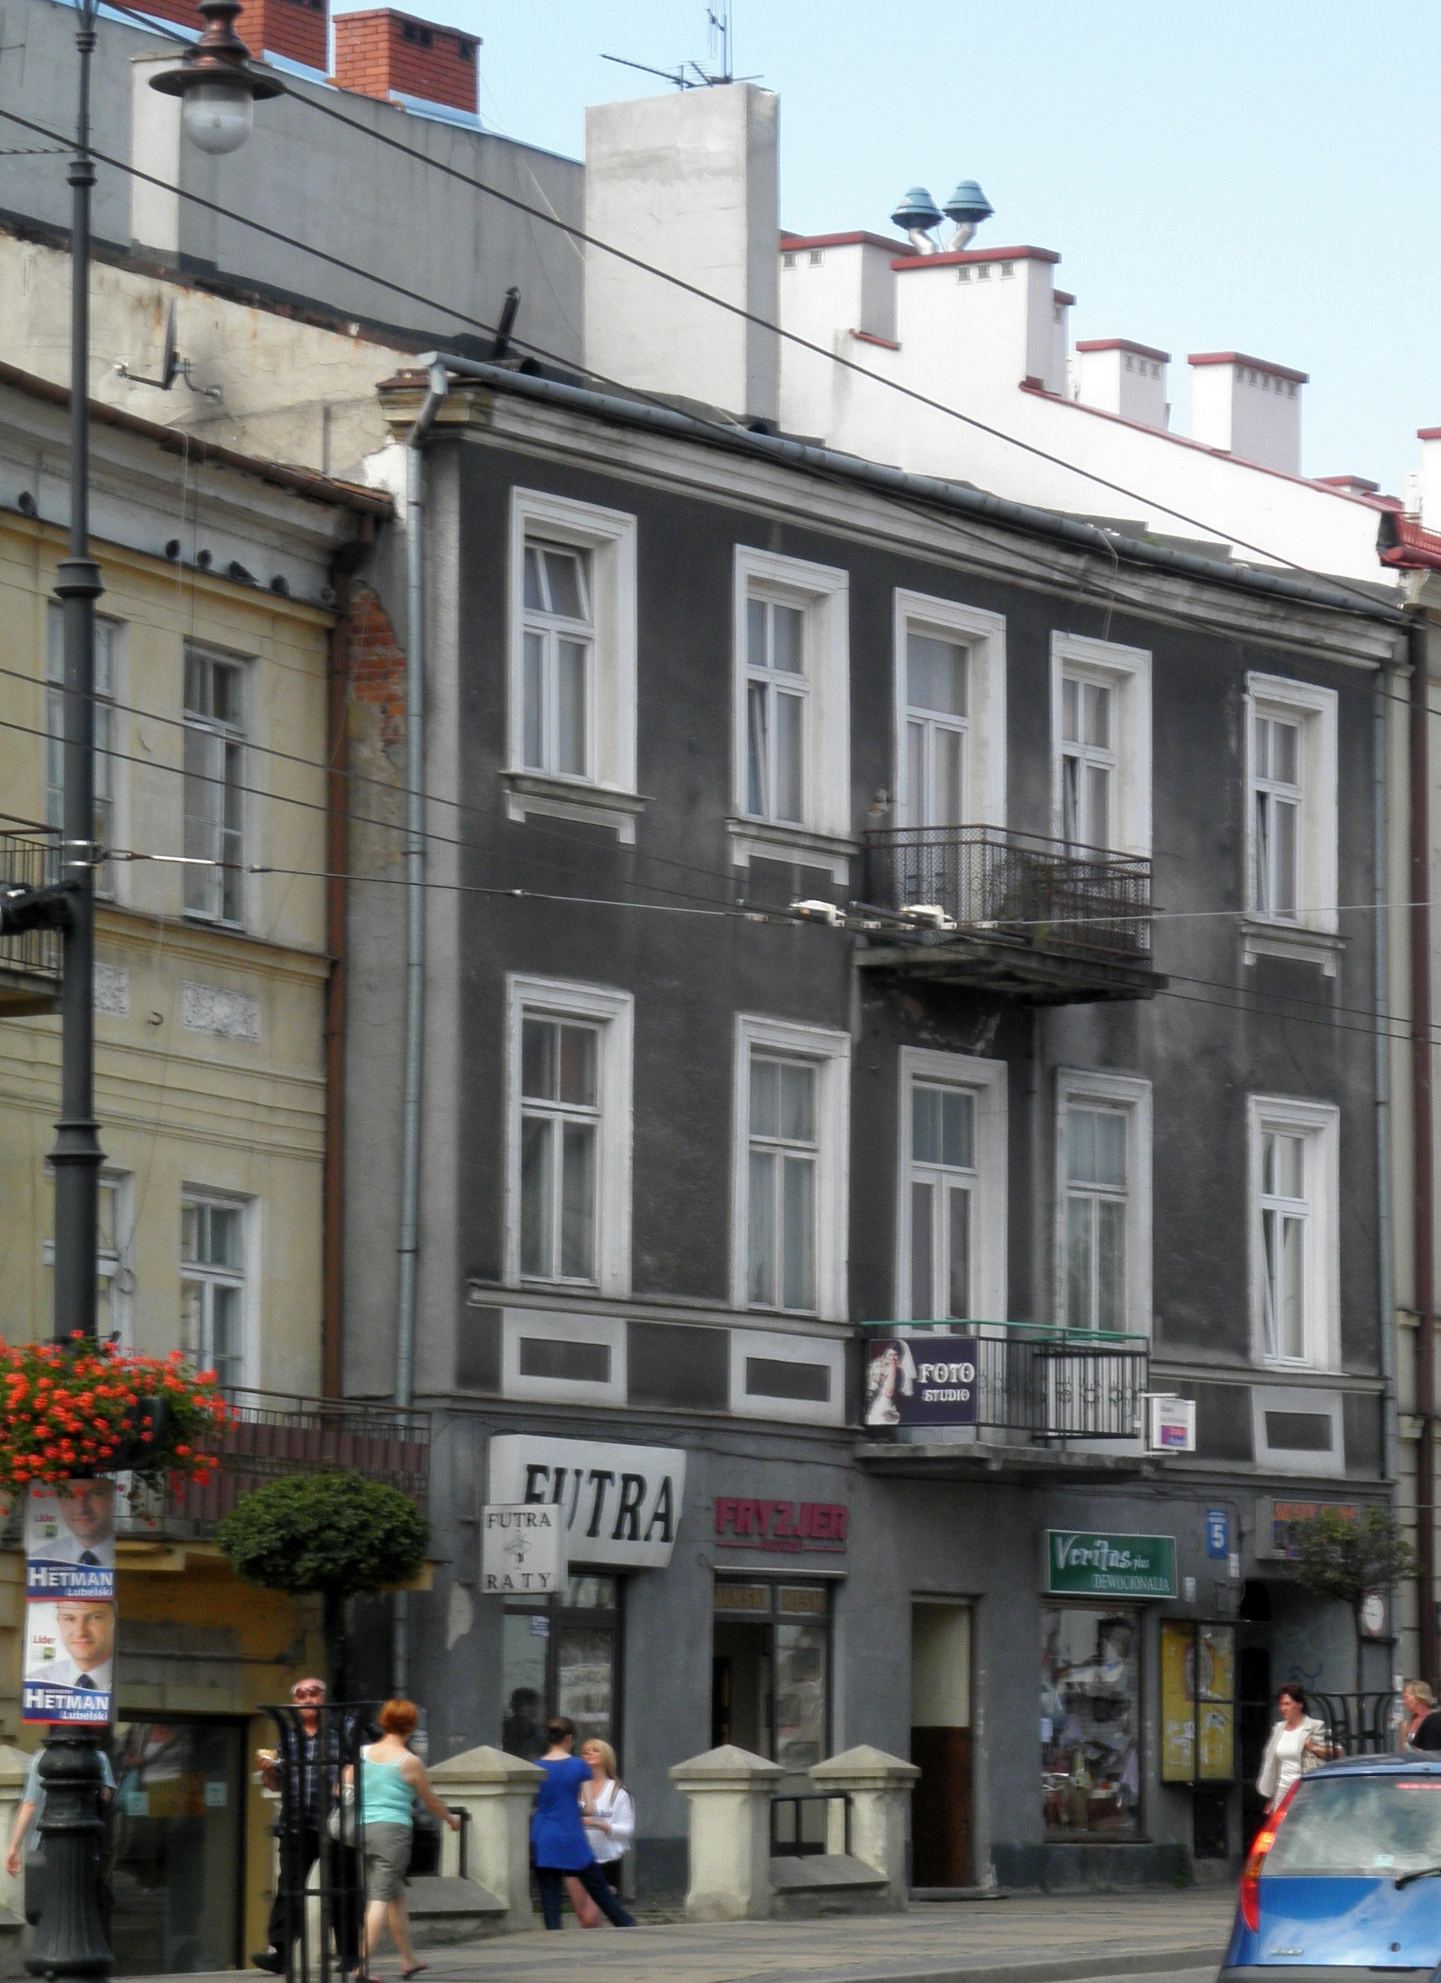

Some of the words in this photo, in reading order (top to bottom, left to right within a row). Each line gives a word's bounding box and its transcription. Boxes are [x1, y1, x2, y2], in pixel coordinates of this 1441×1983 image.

[918, 1362, 976, 1384] FOTO
[922, 1388, 970, 1402] STUDIO
[524, 1463, 675, 1543] FUTRA
[487, 1512, 552, 1529] FUTRA
[714, 1496, 849, 1541] FRYZJER
[1212, 1523, 1225, 1549] 5
[1055, 1534, 1131, 1571] Veritas
[28, 1566, 114, 1587] HETMAN
[487, 1572, 551, 1590] RATY
[66, 1586, 113, 1597] Lubelski
[24, 1688, 110, 1709] HETMAN
[61, 1709, 108, 1720] Lubelski
